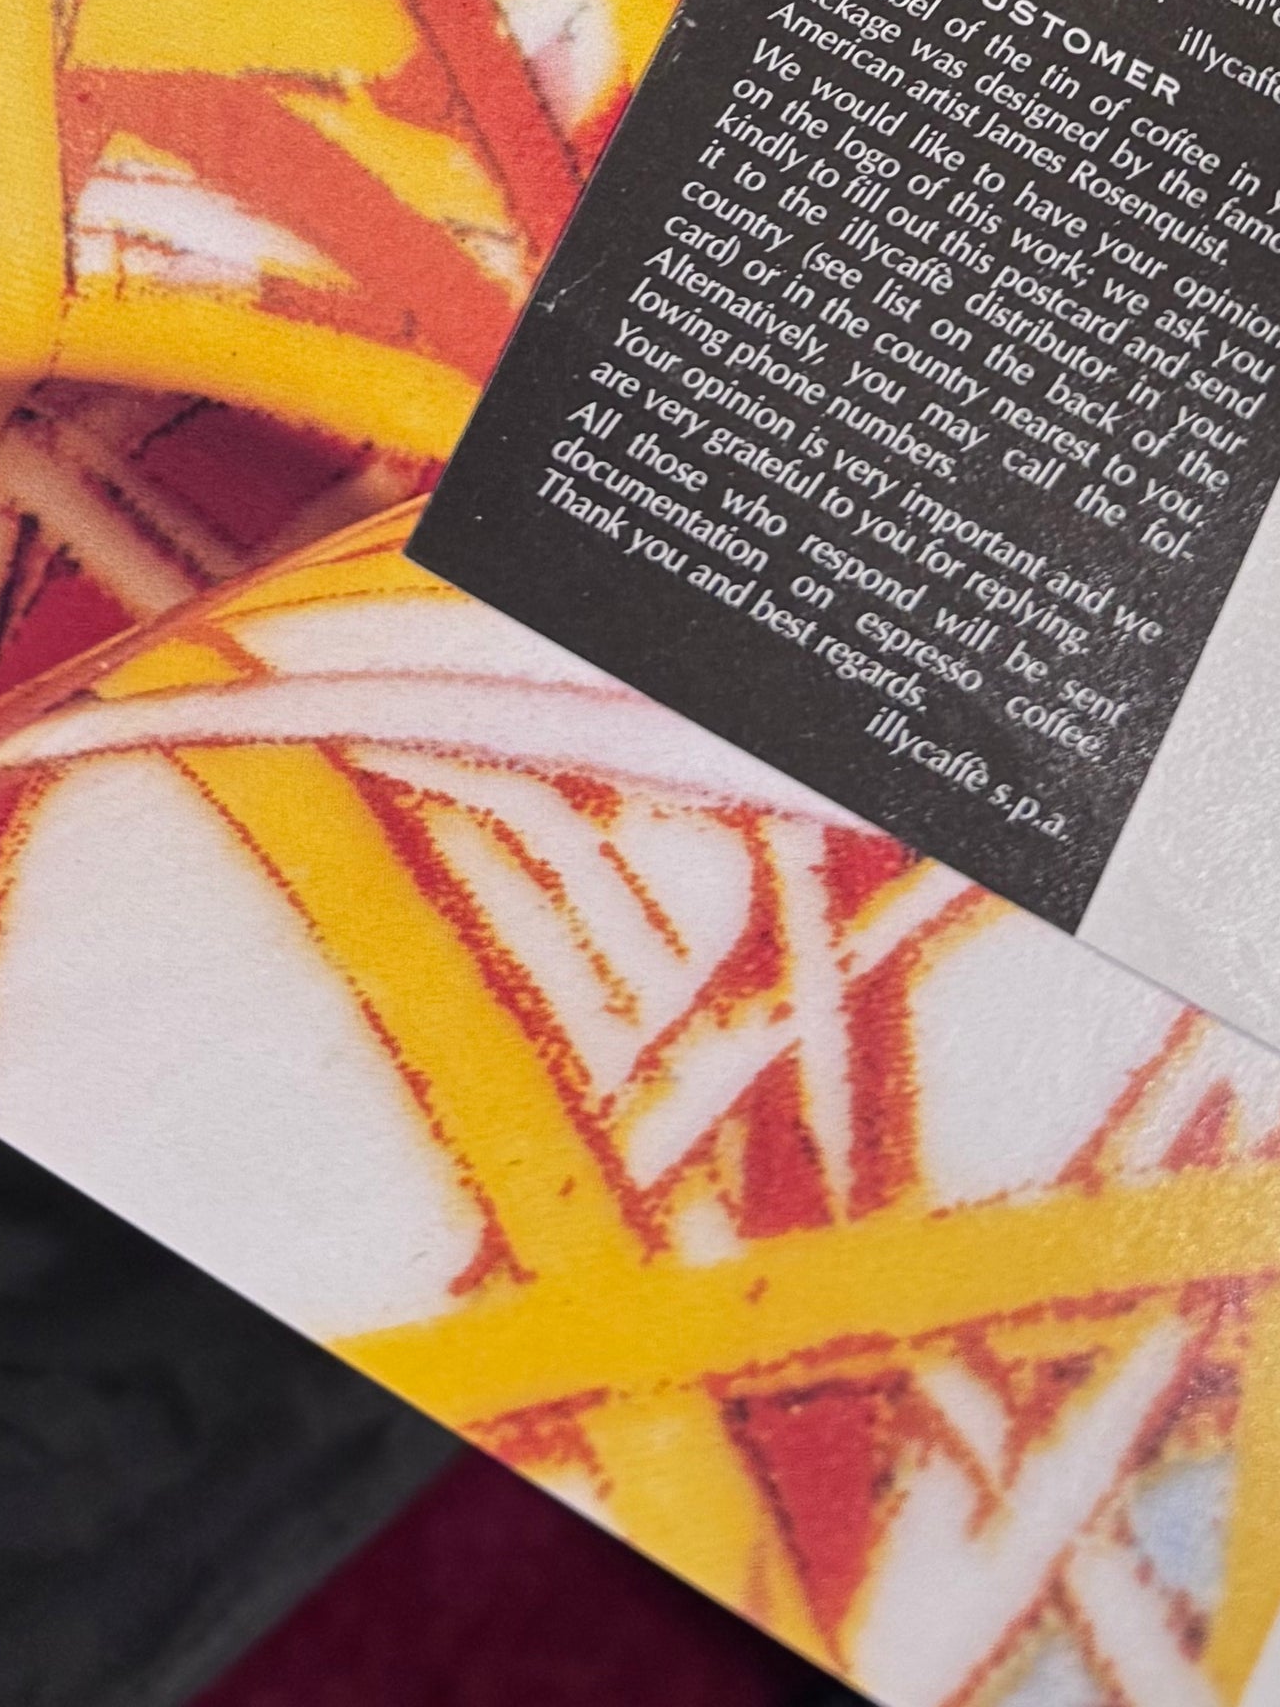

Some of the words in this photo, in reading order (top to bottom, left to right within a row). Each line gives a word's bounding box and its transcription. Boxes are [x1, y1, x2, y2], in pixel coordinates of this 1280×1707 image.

[752, 37, 801, 81] We
[811, 76, 907, 136] would
[908, 124, 965, 171] like
[972, 162, 1005, 193] to
[1013, 180, 1087, 237] have
[1092, 231, 1168, 279] your
[766, 2, 904, 86] American
[906, 79, 980, 127] artist
[973, 112, 1065, 173] James
[1068, 160, 1227, 265] Rosenquist.
[910, 37, 967, 78] was
[974, 72, 1108, 152] designed
[1109, 138, 1152, 180] by
[1157, 168, 1207, 208] the
[943, 17, 982, 43] of
[983, 34, 1032, 72] the
[1039, 63, 1080, 99] tin
[1088, 94, 1128, 121] of
[1130, 116, 1220, 174] coffee
[1228, 160, 1261, 195] in
[628, 277, 730, 356] lowing
[725, 342, 825, 404] phone
[826, 396, 956, 481] numbers.
[681, 180, 793, 252] country
[801, 242, 862, 289] (see
[872, 277, 921, 321] list
[929, 317, 972, 351] on
[983, 343, 1034, 384] the
[1045, 372, 1121, 432] back
[1131, 429, 1173, 457] of
[1177, 449, 1229, 491] the
[714, 103, 807, 172] kindly
[807, 157, 840, 188] to
[841, 174, 890, 213] fill
[885, 205, 939, 242] out
[938, 230, 994, 273] this
[991, 265, 1128, 344] postcard
[1123, 336, 1190, 376] and
[1190, 369, 1266, 418] send
[613, 317, 682, 372] Your
[681, 367, 795, 440] opinion
[798, 425, 828, 457] is
[833, 448, 899, 498] very
[900, 482, 1046, 579] important
[1046, 571, 1115, 614] and
[1113, 604, 1163, 643] we
[644, 247, 827, 364] Alternatively,
[843, 360, 906, 404] you
[919, 402, 989, 451] may
[1001, 448, 1066, 489] call
[1073, 484, 1126, 525] the
[1139, 517, 1194, 563] fol-
[538, 467, 627, 537] Thank
[624, 528, 688, 572] you
[687, 564, 756, 607] and
[748, 589, 816, 645] best
[814, 635, 926, 711] regards.
[551, 437, 768, 571] documentation
[790, 575, 834, 609] on
[855, 612, 982, 691] espresso
[1004, 695, 1101, 762] coffee.
[864, 706, 988, 791] illycaffè
[988, 783, 1068, 841] s.p.a.
